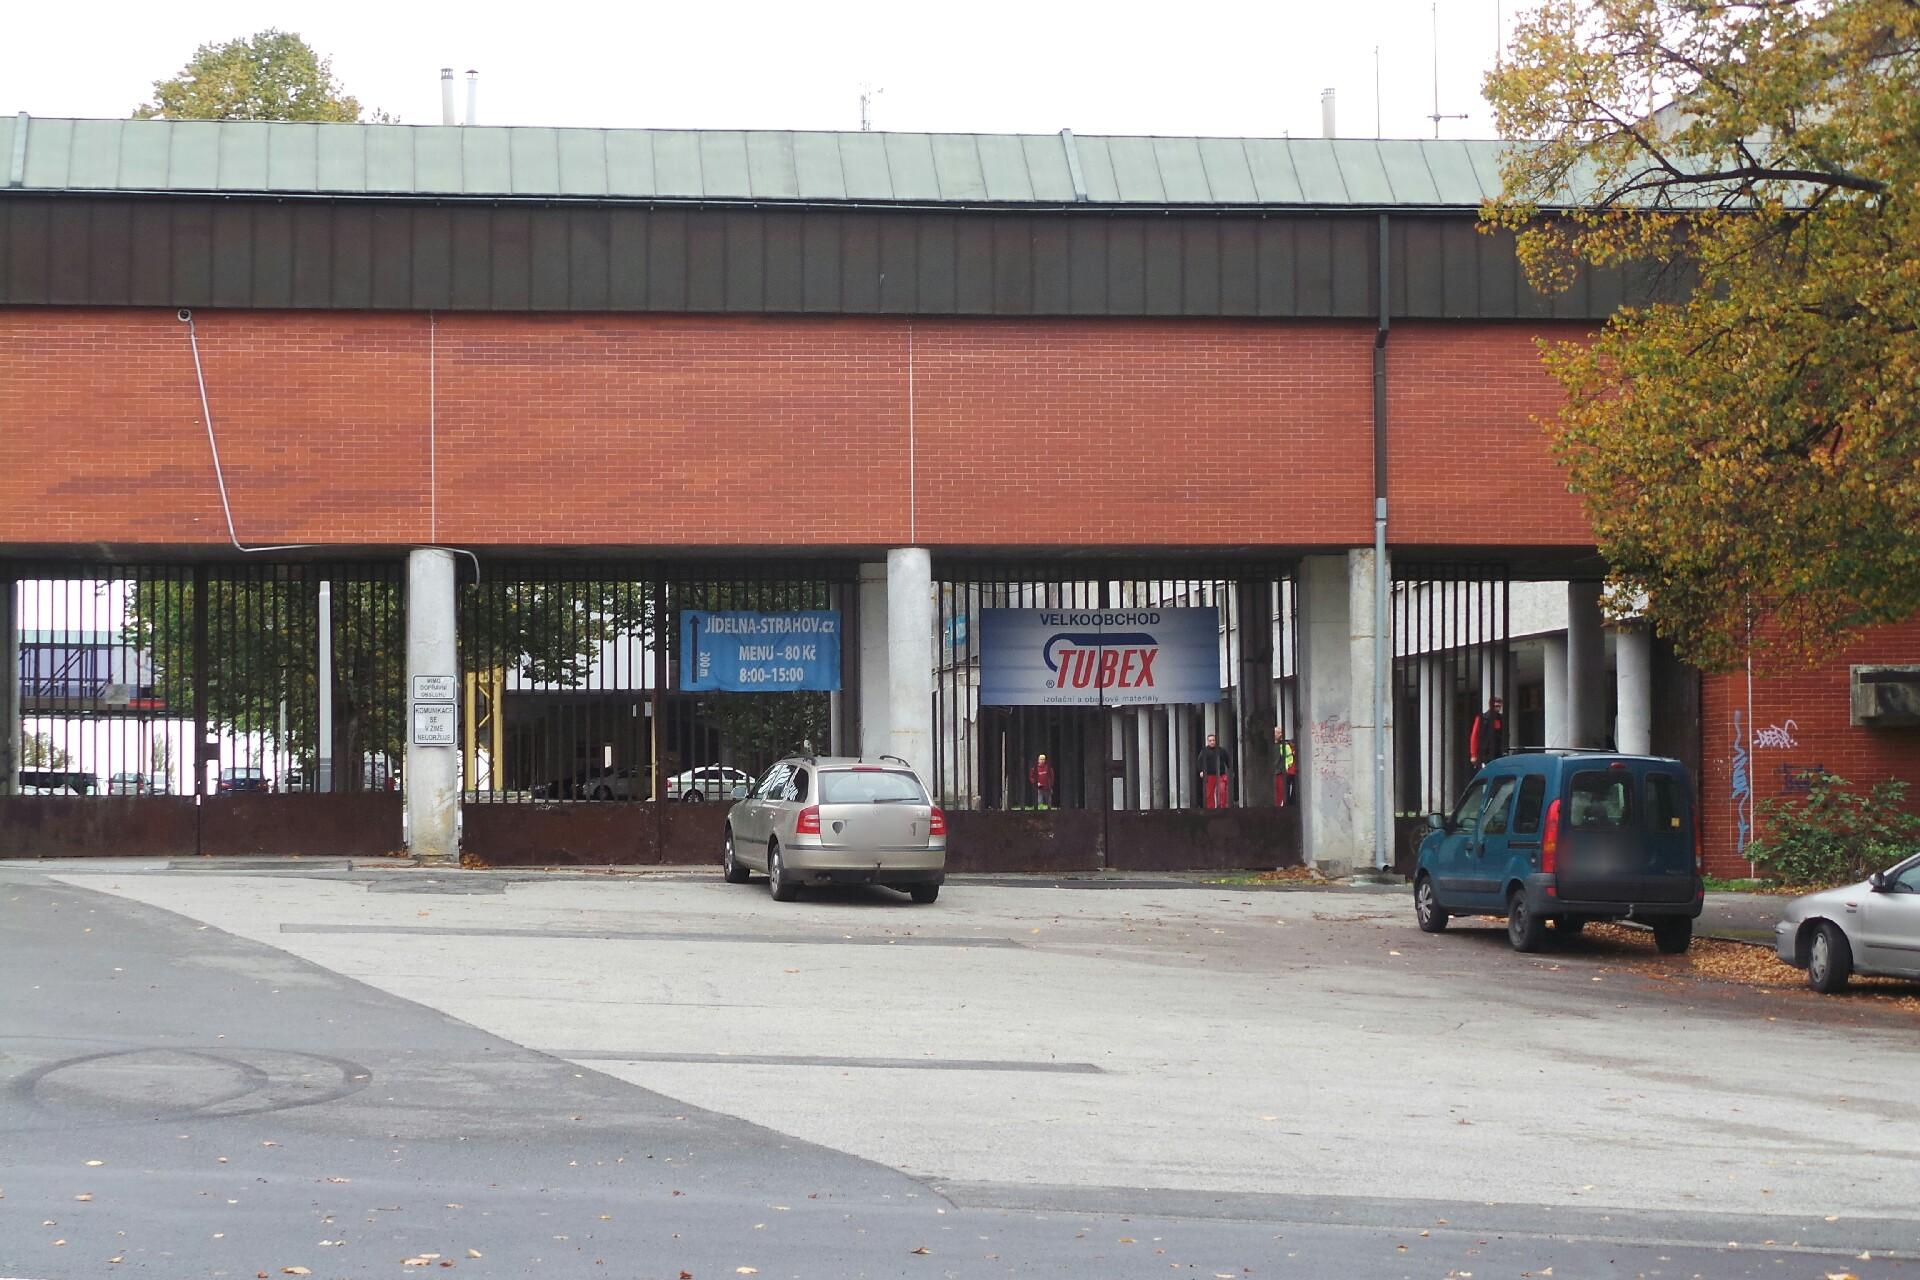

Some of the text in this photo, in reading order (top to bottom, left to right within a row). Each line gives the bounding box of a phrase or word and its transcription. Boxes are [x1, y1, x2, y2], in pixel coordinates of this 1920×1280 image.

[705, 615, 834, 633] JÍDELNA-STRAHOV.cz
[1040, 612, 1160, 625] VELKOOBCHOD
[739, 646, 774, 661] MENU
[785, 646, 800, 661] 80
[803, 645, 816, 661] Kč
[700, 652, 711, 677] 200 m
[1057, 649, 1158, 688] TUBEX
